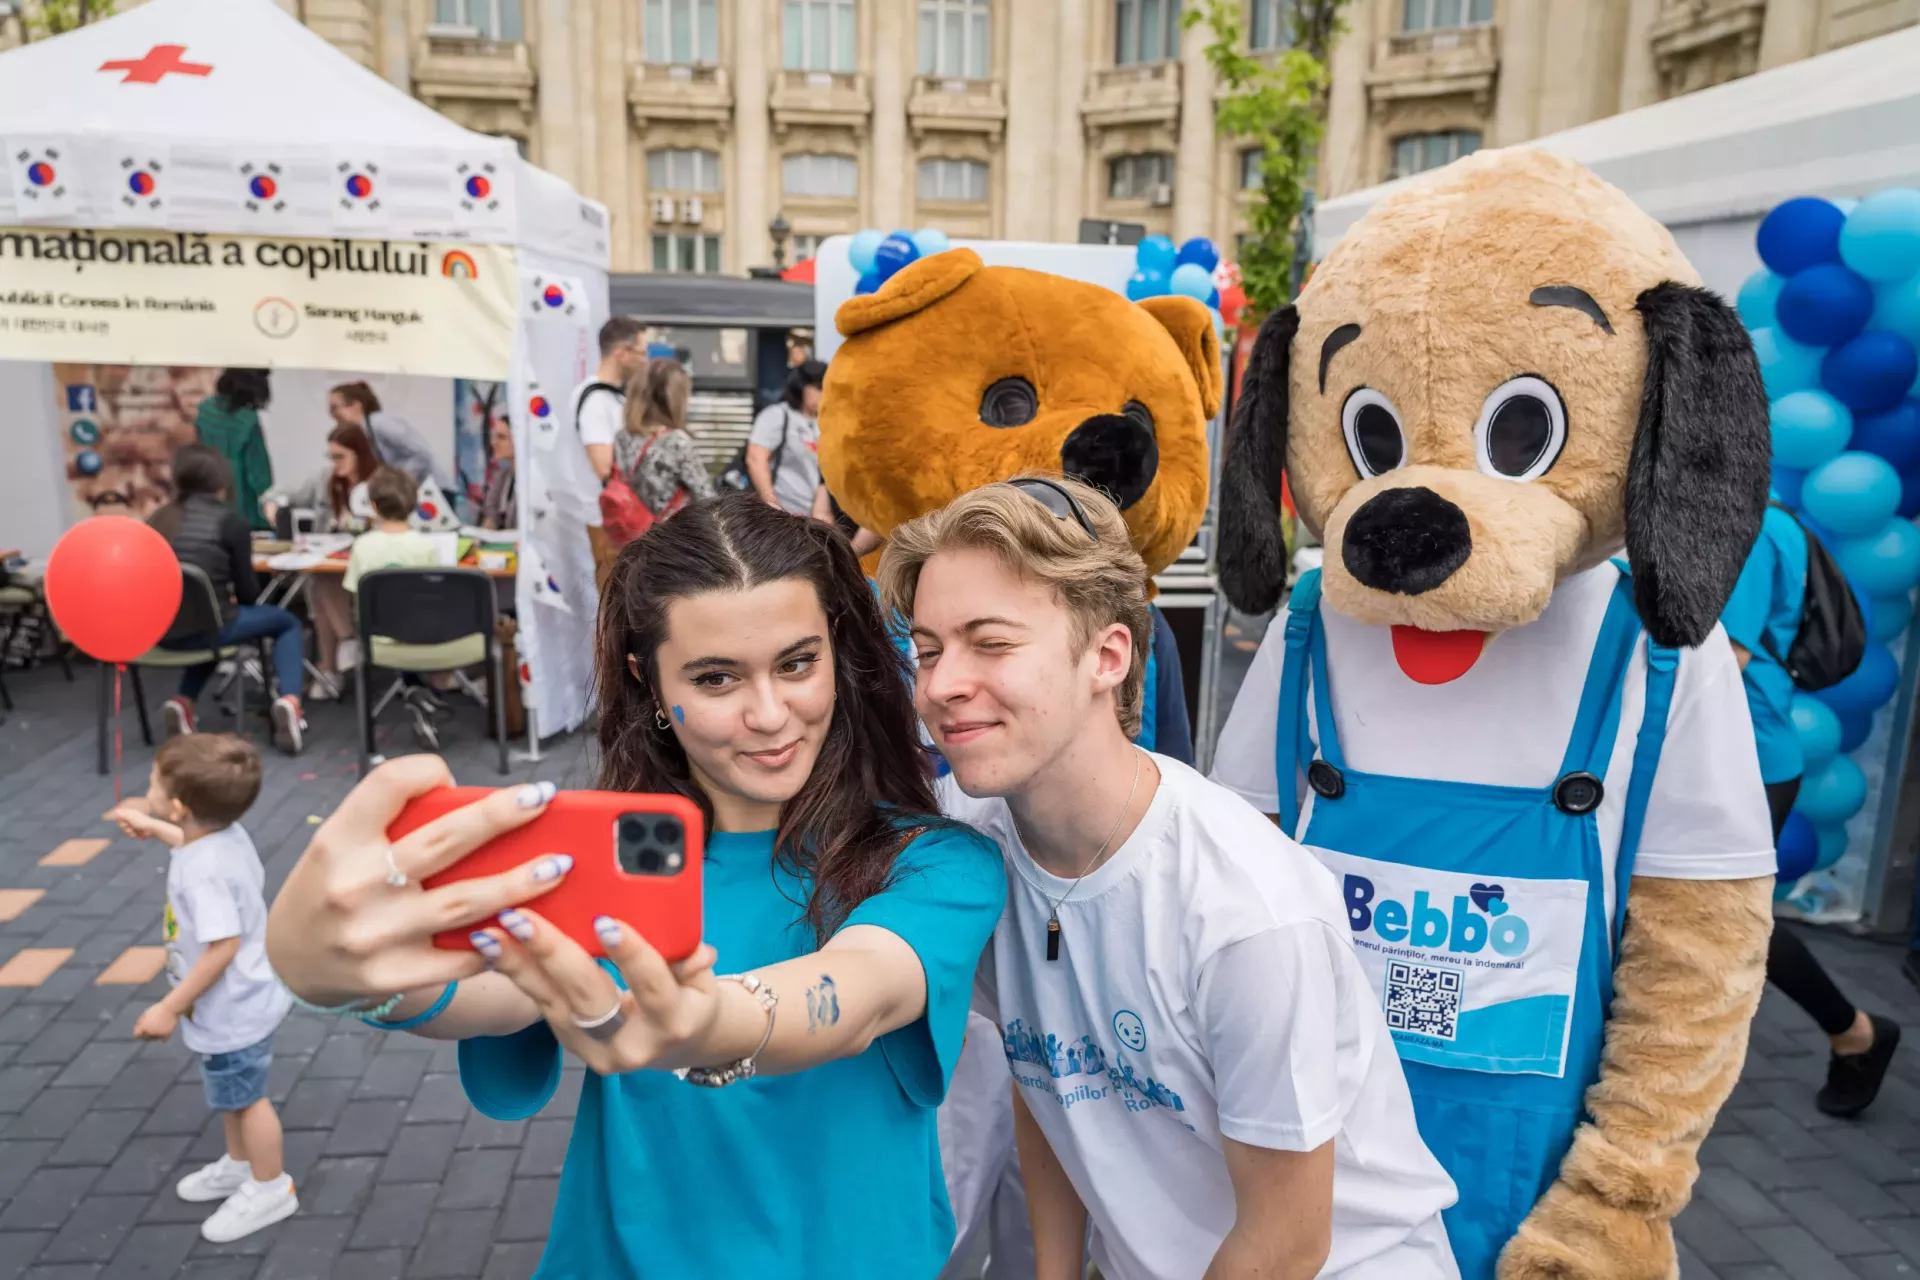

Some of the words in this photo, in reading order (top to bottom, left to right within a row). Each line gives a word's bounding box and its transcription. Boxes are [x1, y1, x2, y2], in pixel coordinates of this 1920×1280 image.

[222, 241, 245, 266] a
[256, 238, 428, 280] copilului
[1343, 873, 1530, 957] Bebbo
[1463, 958, 1472, 966] la
